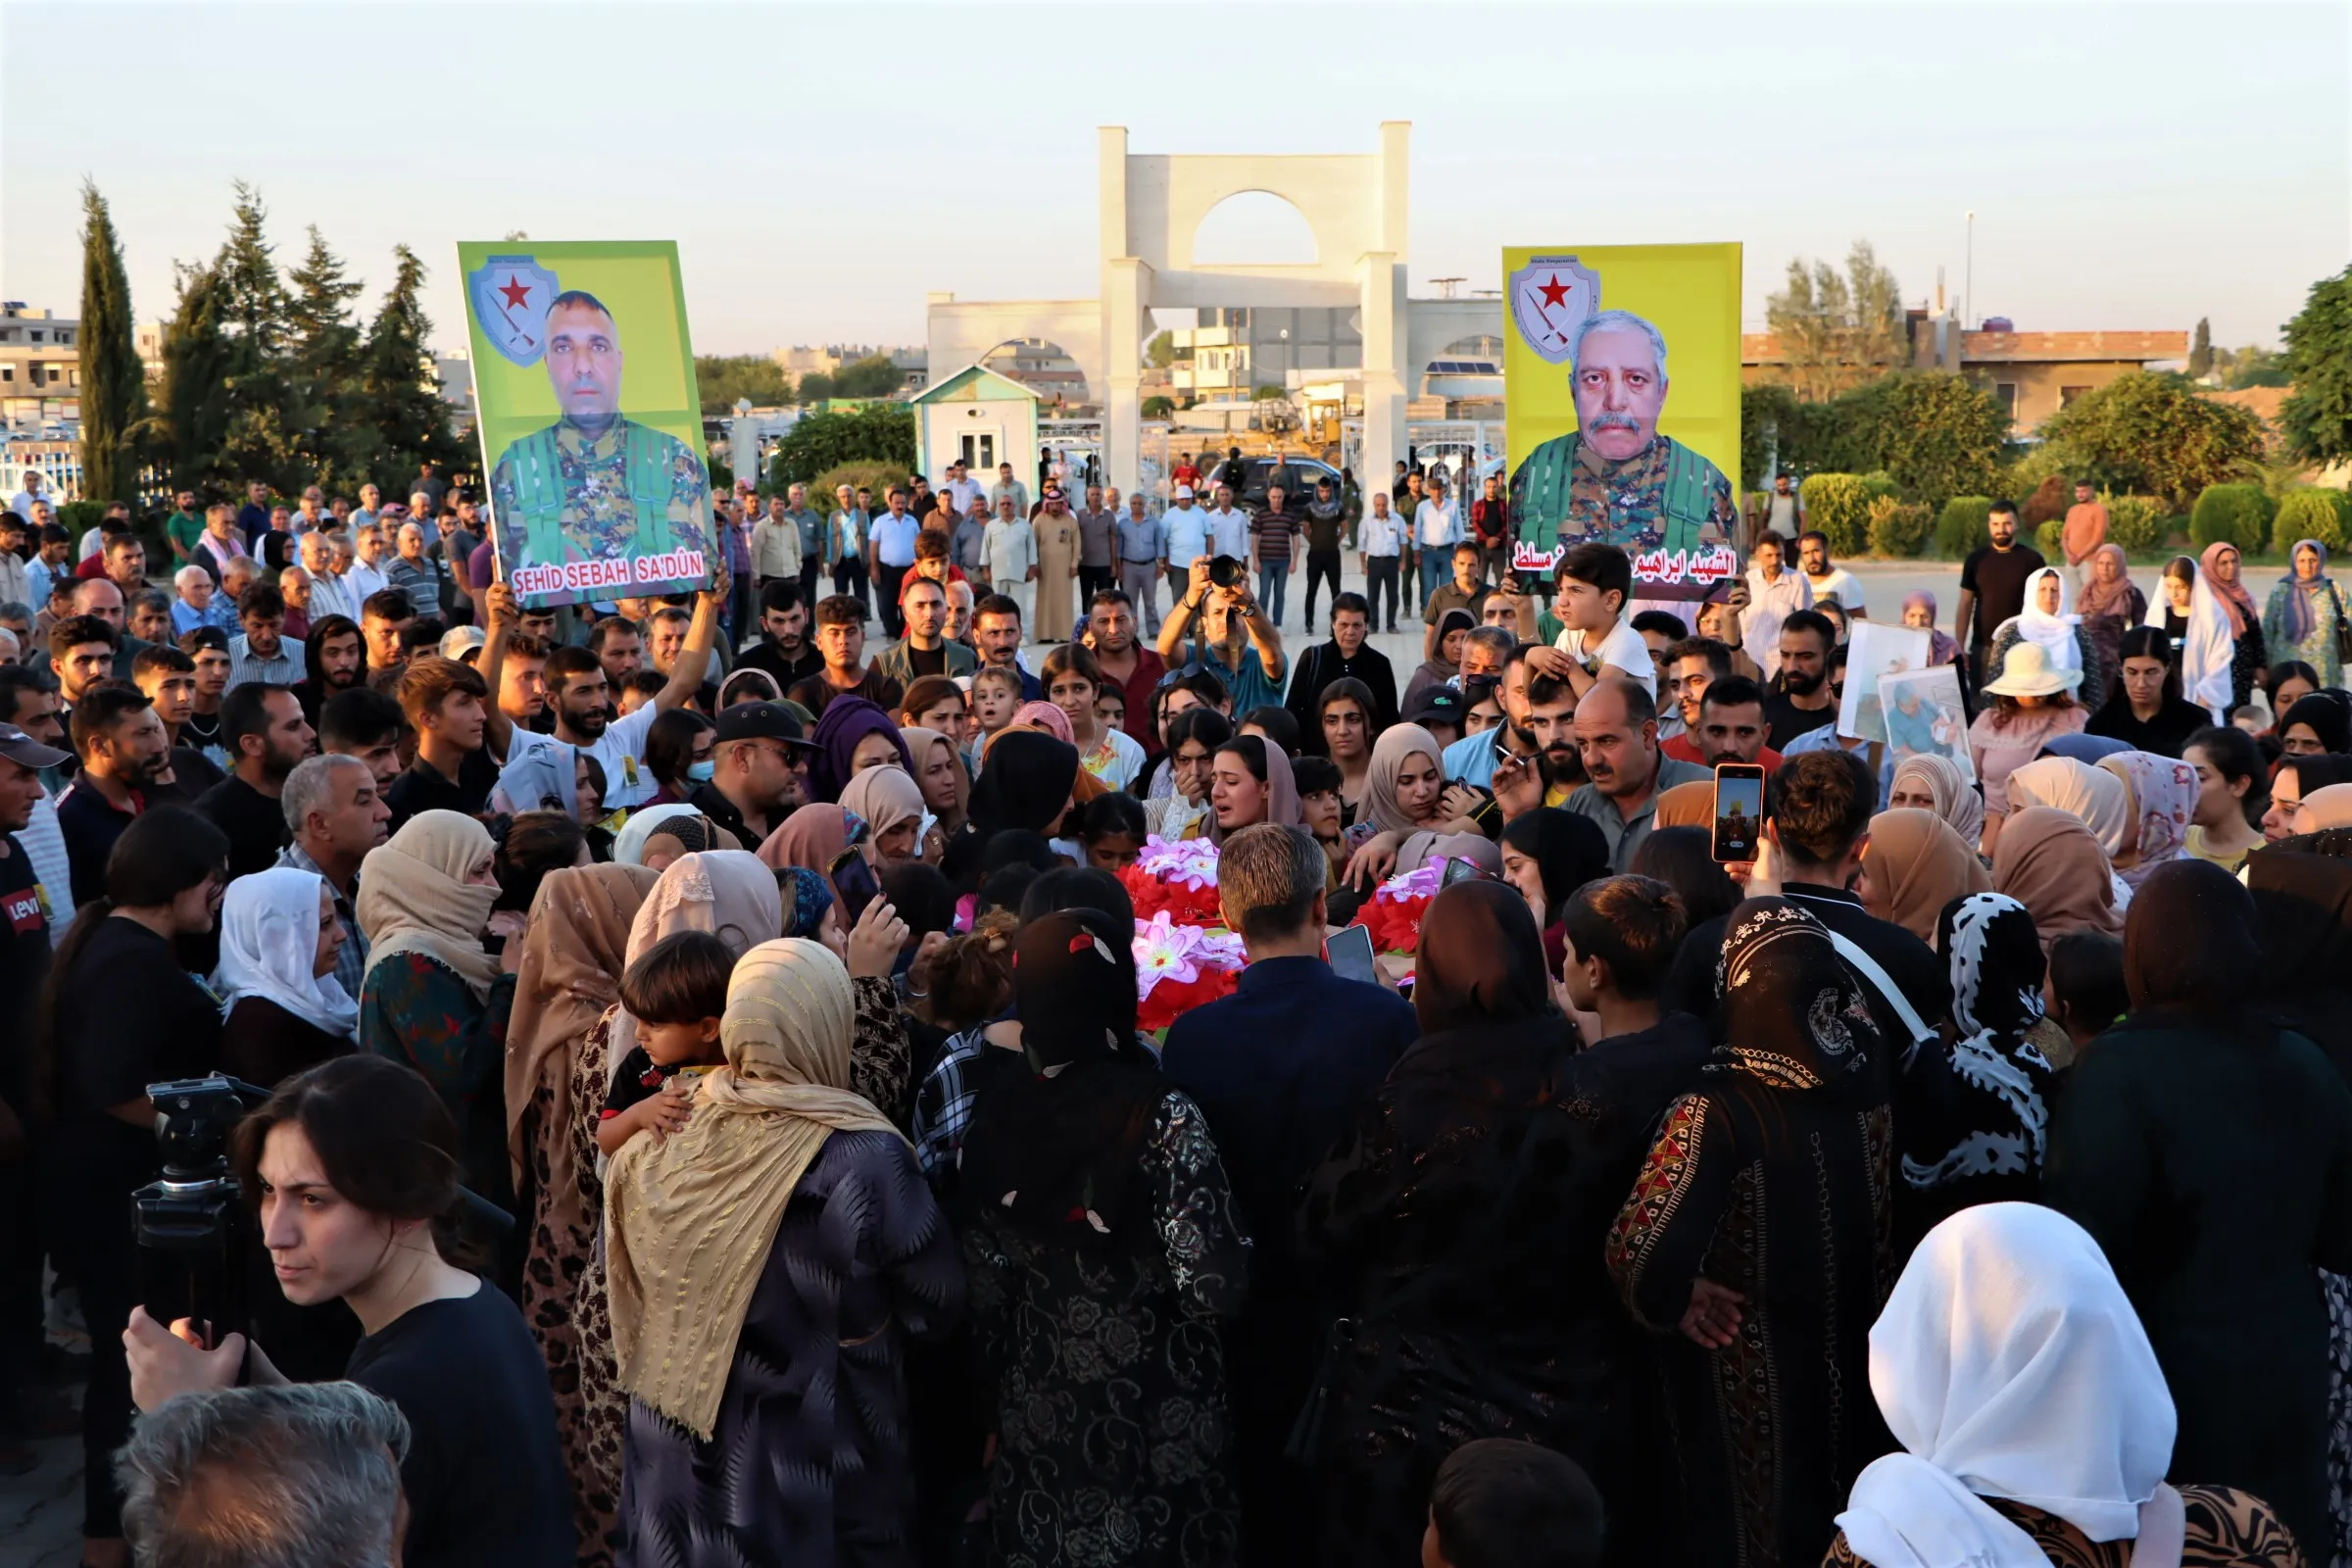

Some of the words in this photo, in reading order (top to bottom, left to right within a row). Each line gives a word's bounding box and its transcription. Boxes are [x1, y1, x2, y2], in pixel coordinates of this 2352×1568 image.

[1515, 545, 1551, 567] مسلط
[1636, 552, 1686, 582] ابراهيم
[1690, 551, 1735, 581] الشهيد
[514, 565, 564, 599] ŞEHÎD
[566, 561, 629, 587] SEBAH
[637, 549, 703, 580] SA'DÛN
